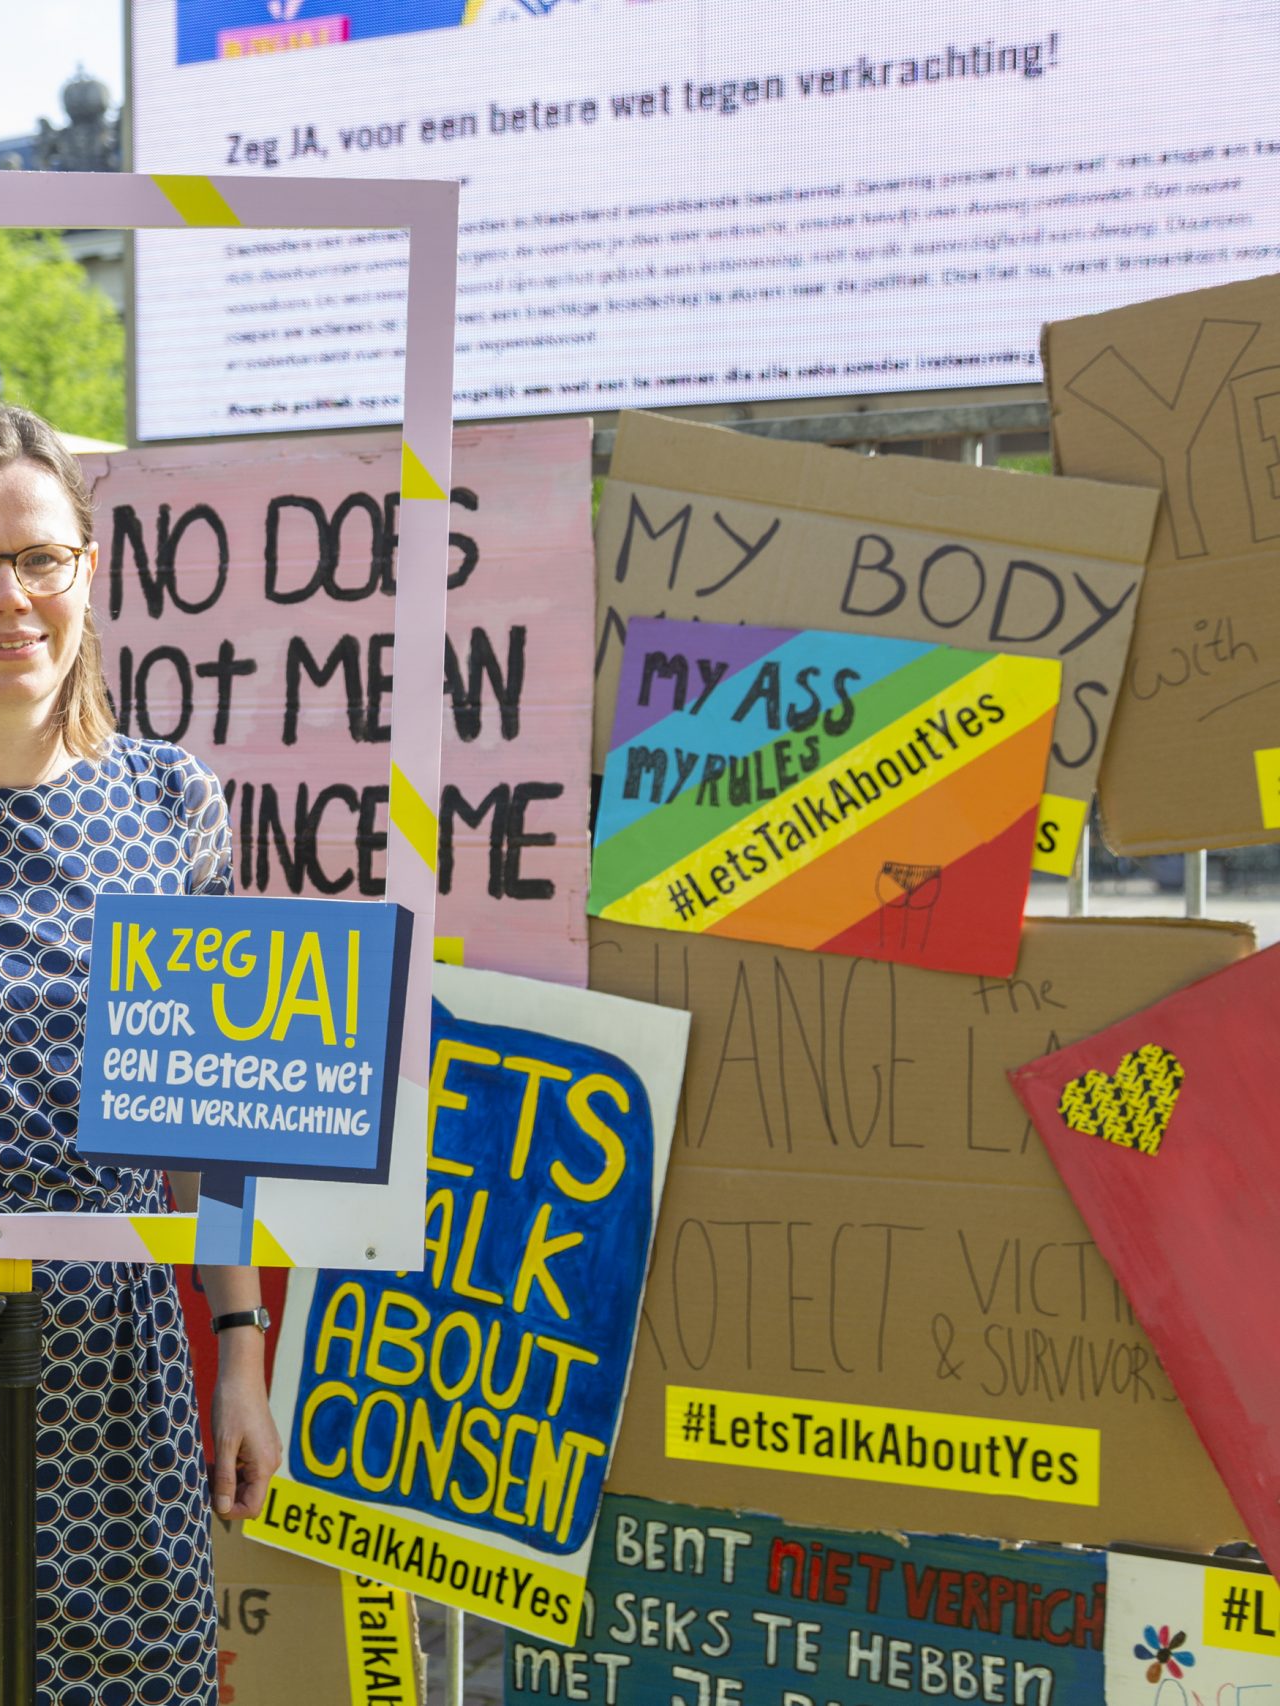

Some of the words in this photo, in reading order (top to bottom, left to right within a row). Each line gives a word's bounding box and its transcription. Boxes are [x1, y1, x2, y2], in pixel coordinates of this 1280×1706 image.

[227, 133, 280, 168] Zeg
[289, 124, 328, 159] JA,
[340, 120, 407, 152] voor
[421, 113, 477, 142] een
[489, 97, 597, 134] betere
[612, 84, 671, 118] wet
[682, 72, 785, 114] tegen
[797, 31, 1060, 96] verkrachting!
[110, 502, 230, 620] NO
[616, 493, 782, 597] MY
[841, 534, 1138, 655] BODY
[730, 661, 862, 737] ASS
[1130, 617, 1258, 701] with
[224, 778, 389, 898] INCE
[438, 781, 564, 899] ME
[669, 692, 1007, 922] #LetsTalkAboutYes
[109, 920, 163, 992] IK
[211, 929, 361, 1049] JA!
[397, 1188, 585, 1321] ALK
[642, 1217, 924, 1374] OTECT
[958, 1228, 1135, 1326] VICTI
[314, 1281, 600, 1418] ABOUT
[931, 1313, 965, 1381] &
[300, 1380, 606, 1545] CONSENT
[681, 1401, 1080, 1486] #LetsTalkAboutYes
[263, 1487, 572, 1626] LetsTalkAboutYes
[609, 1592, 731, 1657] SEKS
[752, 1611, 821, 1673] TE
